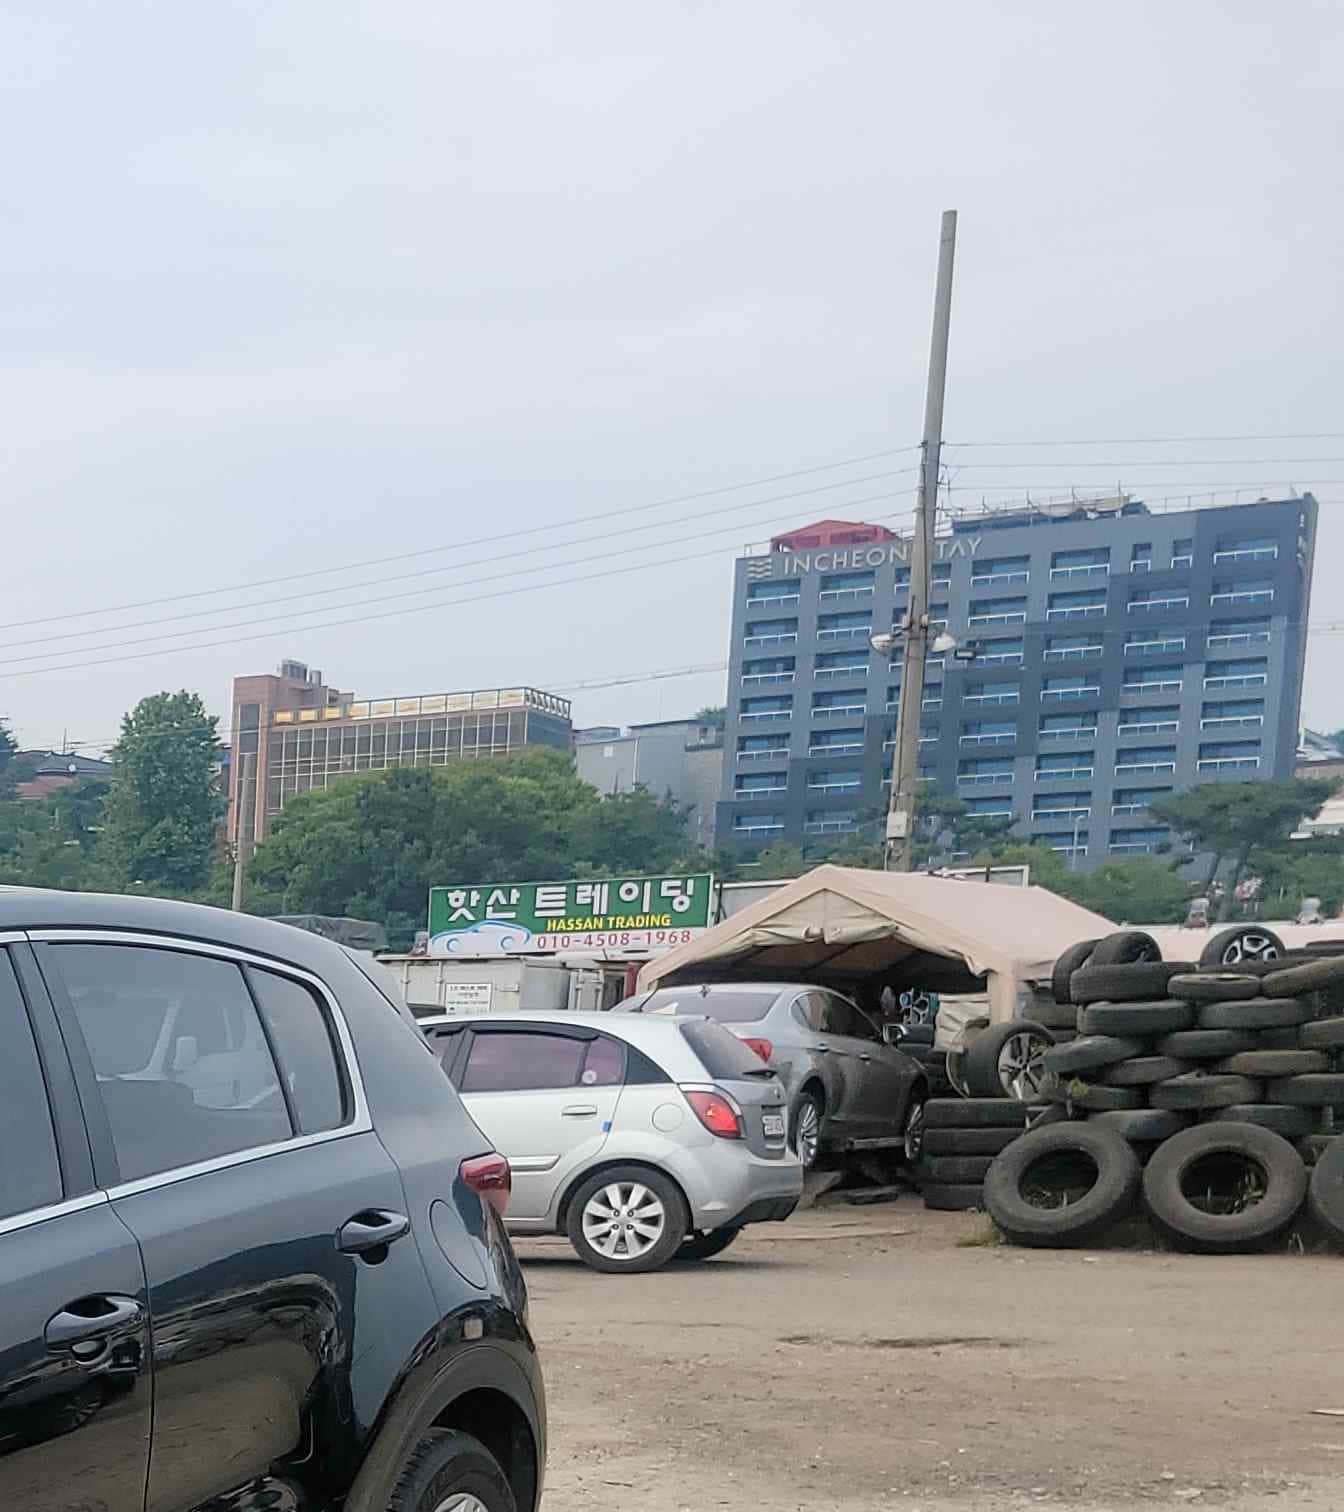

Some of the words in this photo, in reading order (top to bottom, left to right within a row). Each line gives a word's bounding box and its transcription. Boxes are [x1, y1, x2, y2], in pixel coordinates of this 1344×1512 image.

[784, 544, 909, 575] INCHEON
[930, 537, 982, 559] TAY
[448, 888, 520, 922] 핫산
[534, 879, 694, 918] 트레이딩
[546, 917, 604, 932] HASSAN
[607, 914, 672, 930] TRADING
[536, 931, 692, 949] 010-4508-1968
